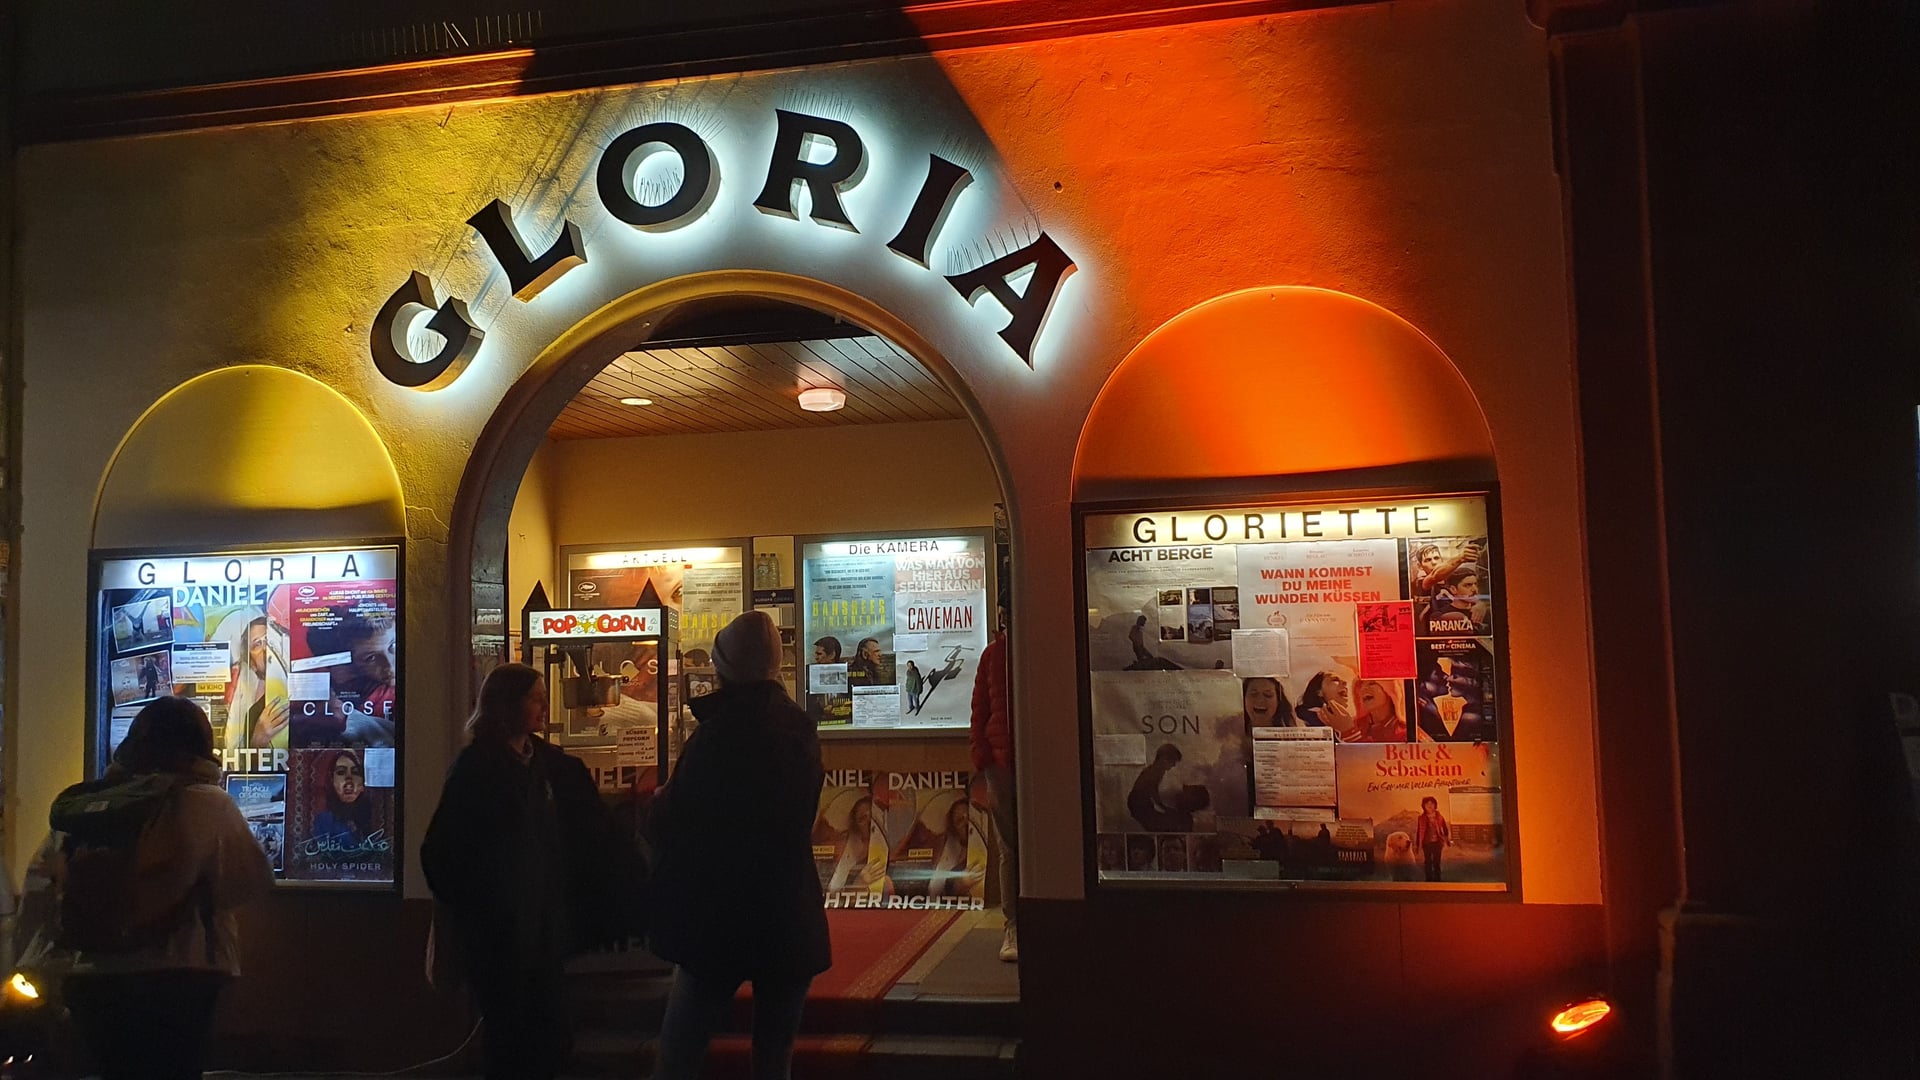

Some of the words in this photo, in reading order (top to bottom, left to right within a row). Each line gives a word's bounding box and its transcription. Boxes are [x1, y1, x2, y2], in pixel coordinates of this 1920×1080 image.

[369, 107, 1079, 391] GLORIA
[1132, 506, 1431, 543] GLORIETTE
[849, 544, 871, 555] Die
[877, 540, 939, 554] KAMERA
[1108, 549, 1153, 563] ACHT
[1157, 547, 1213, 561] BERGE
[137, 554, 360, 586] GLORIA
[896, 559, 922, 570] WAS
[926, 558, 953, 570] MAN
[956, 557, 984, 569] VON
[912, 570, 942, 581] HIER
[945, 569, 971, 580] AUS
[1260, 567, 1306, 580] WANN
[1309, 566, 1373, 578] KOMMST
[899, 581, 941, 593] SEHEN
[945, 579, 981, 591] KANN
[1282, 580, 1302, 591] DU
[1306, 579, 1352, 590] MEINE
[172, 584, 265, 608] DANIEL
[1255, 593, 1319, 604] WUNDEN
[1323, 589, 1381, 602] KÜSSEN
[543, 615, 578, 634] POP
[597, 614, 647, 633] CORN
[908, 605, 973, 630] CAVEMAN
[1429, 618, 1474, 632] PARANZA
[1450, 642, 1477, 650] CINEMA
[303, 700, 393, 717] CLOSE
[1141, 714, 1200, 735] SON
[213, 748, 290, 772] HTER
[1385, 744, 1431, 761] Belle
[1435, 744, 1453, 761] &
[1376, 759, 1463, 777] Sebastian
[888, 770, 967, 790] DANIEL
[310, 862, 337, 871] HOLY
[342, 861, 382, 870] SPIDER
[888, 894, 985, 911] RICHTER
